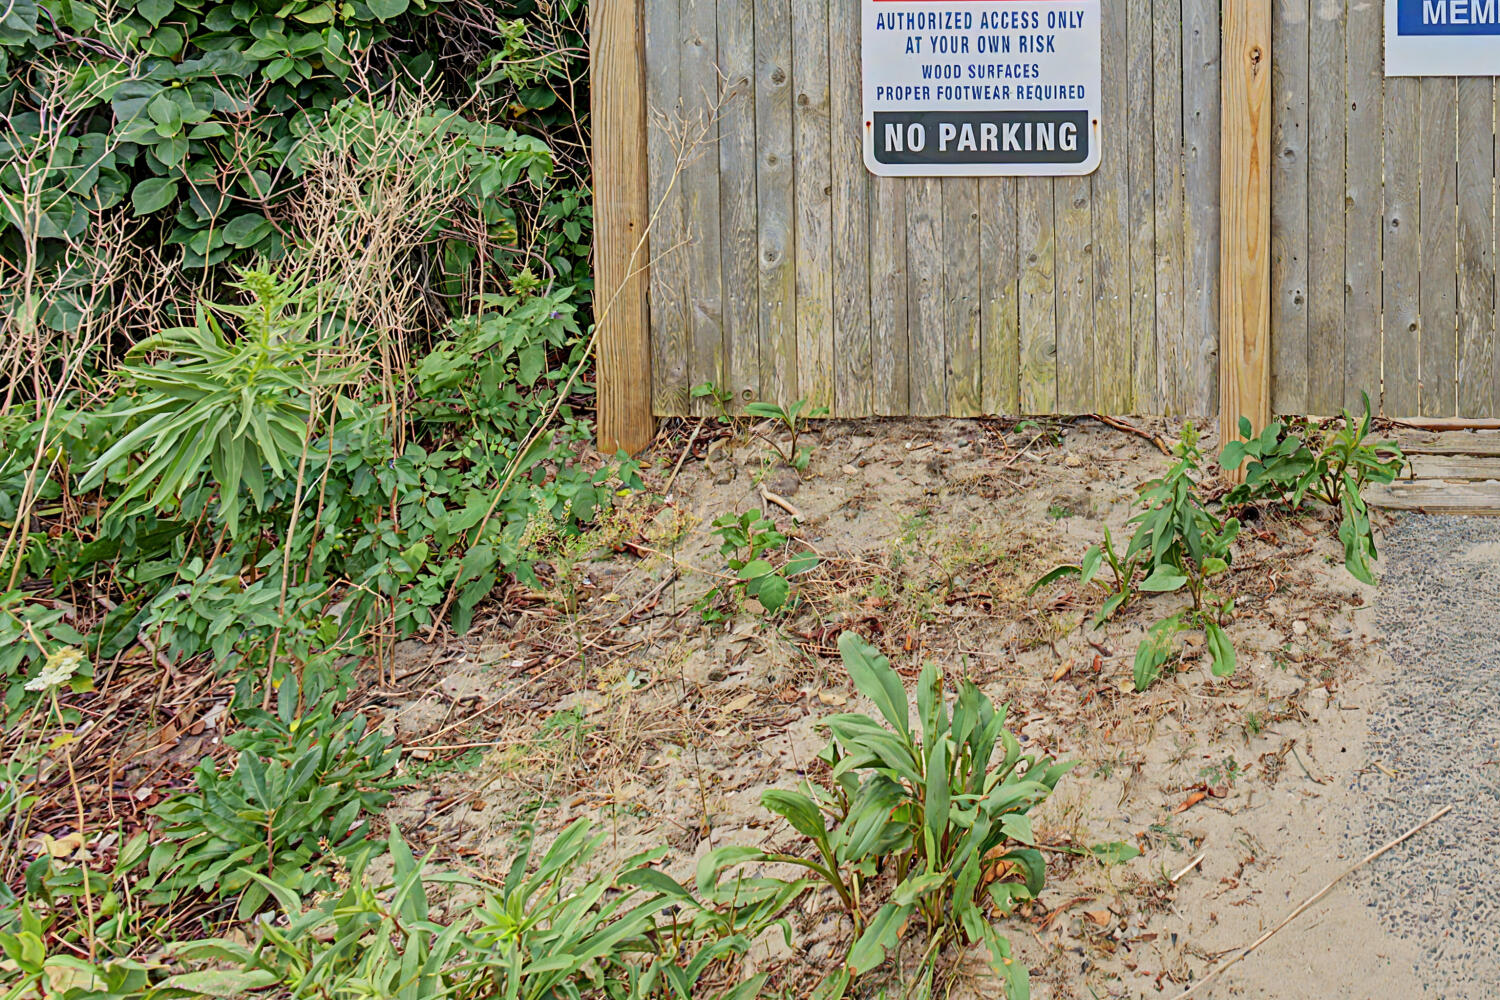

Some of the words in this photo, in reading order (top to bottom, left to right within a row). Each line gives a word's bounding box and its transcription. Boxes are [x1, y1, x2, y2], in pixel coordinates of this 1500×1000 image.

[876, 11, 973, 31] AUTHORIZED
[980, 10, 1039, 30] ACCESS
[1047, 10, 1085, 29] ONLY
[905, 36, 923, 55] AT
[930, 35, 969, 54] YOUR
[977, 35, 1010, 54] OWN
[1019, 34, 1055, 54] RISK
[921, 64, 962, 80] WOOD
[967, 63, 1040, 79] SURFACES
[876, 85, 930, 101] PROPER
[936, 85, 1010, 101] FOOTWEAR
[1016, 84, 1085, 102] REQUIRED
[884, 122, 926, 153] NO
[938, 121, 1077, 152] PARKING
